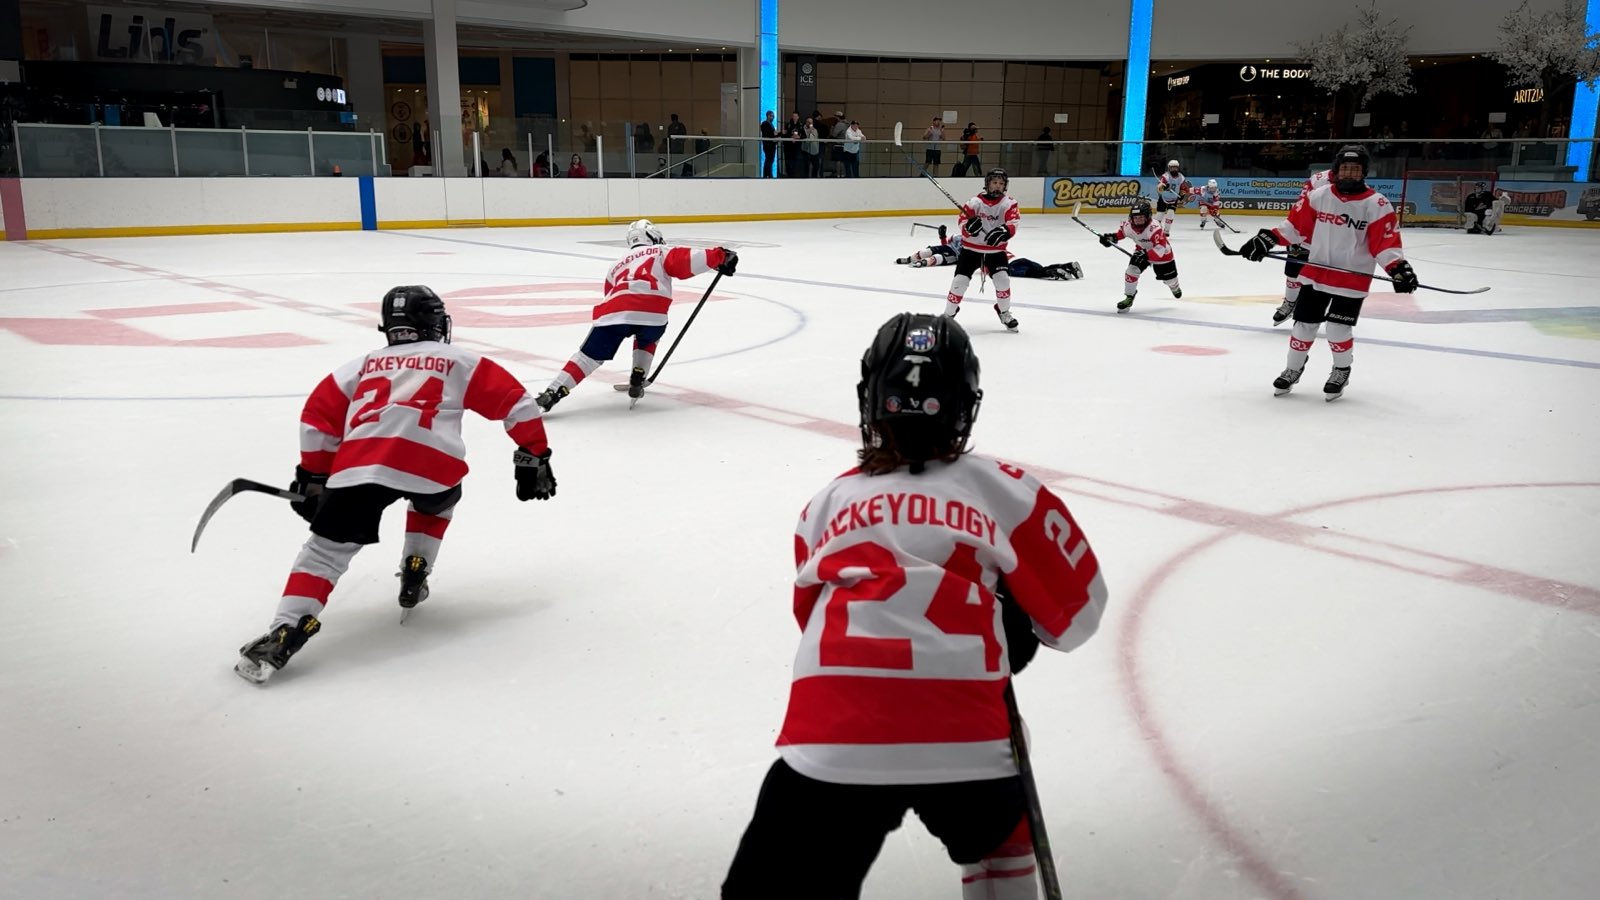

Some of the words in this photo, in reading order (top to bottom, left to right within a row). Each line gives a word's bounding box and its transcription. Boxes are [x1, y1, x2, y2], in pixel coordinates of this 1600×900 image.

[97, 13, 204, 60] Lids
[800, 75, 814, 84] ICE
[1260, 69, 1280, 79] THE
[1282, 69, 1312, 79] BODY
[1513, 88, 1544, 103] ARITZIA
[1226, 180, 1250, 188] Expert
[1251, 180, 1276, 188] Design
[1276, 180, 1292, 188] and
[1052, 178, 1140, 206] Bananas
[1219, 188, 1236, 196] VAC,
[1273, 189, 1302, 197] Contrac
[1097, 196, 1137, 208] Creative
[1218, 201, 1245, 210] OGOS
[1504, 205, 1549, 215] CONCRETE
[905, 365, 920, 387] 4
[350, 376, 444, 430] 24
[1044, 509, 1089, 571] 2
[817, 541, 1003, 673] 24
